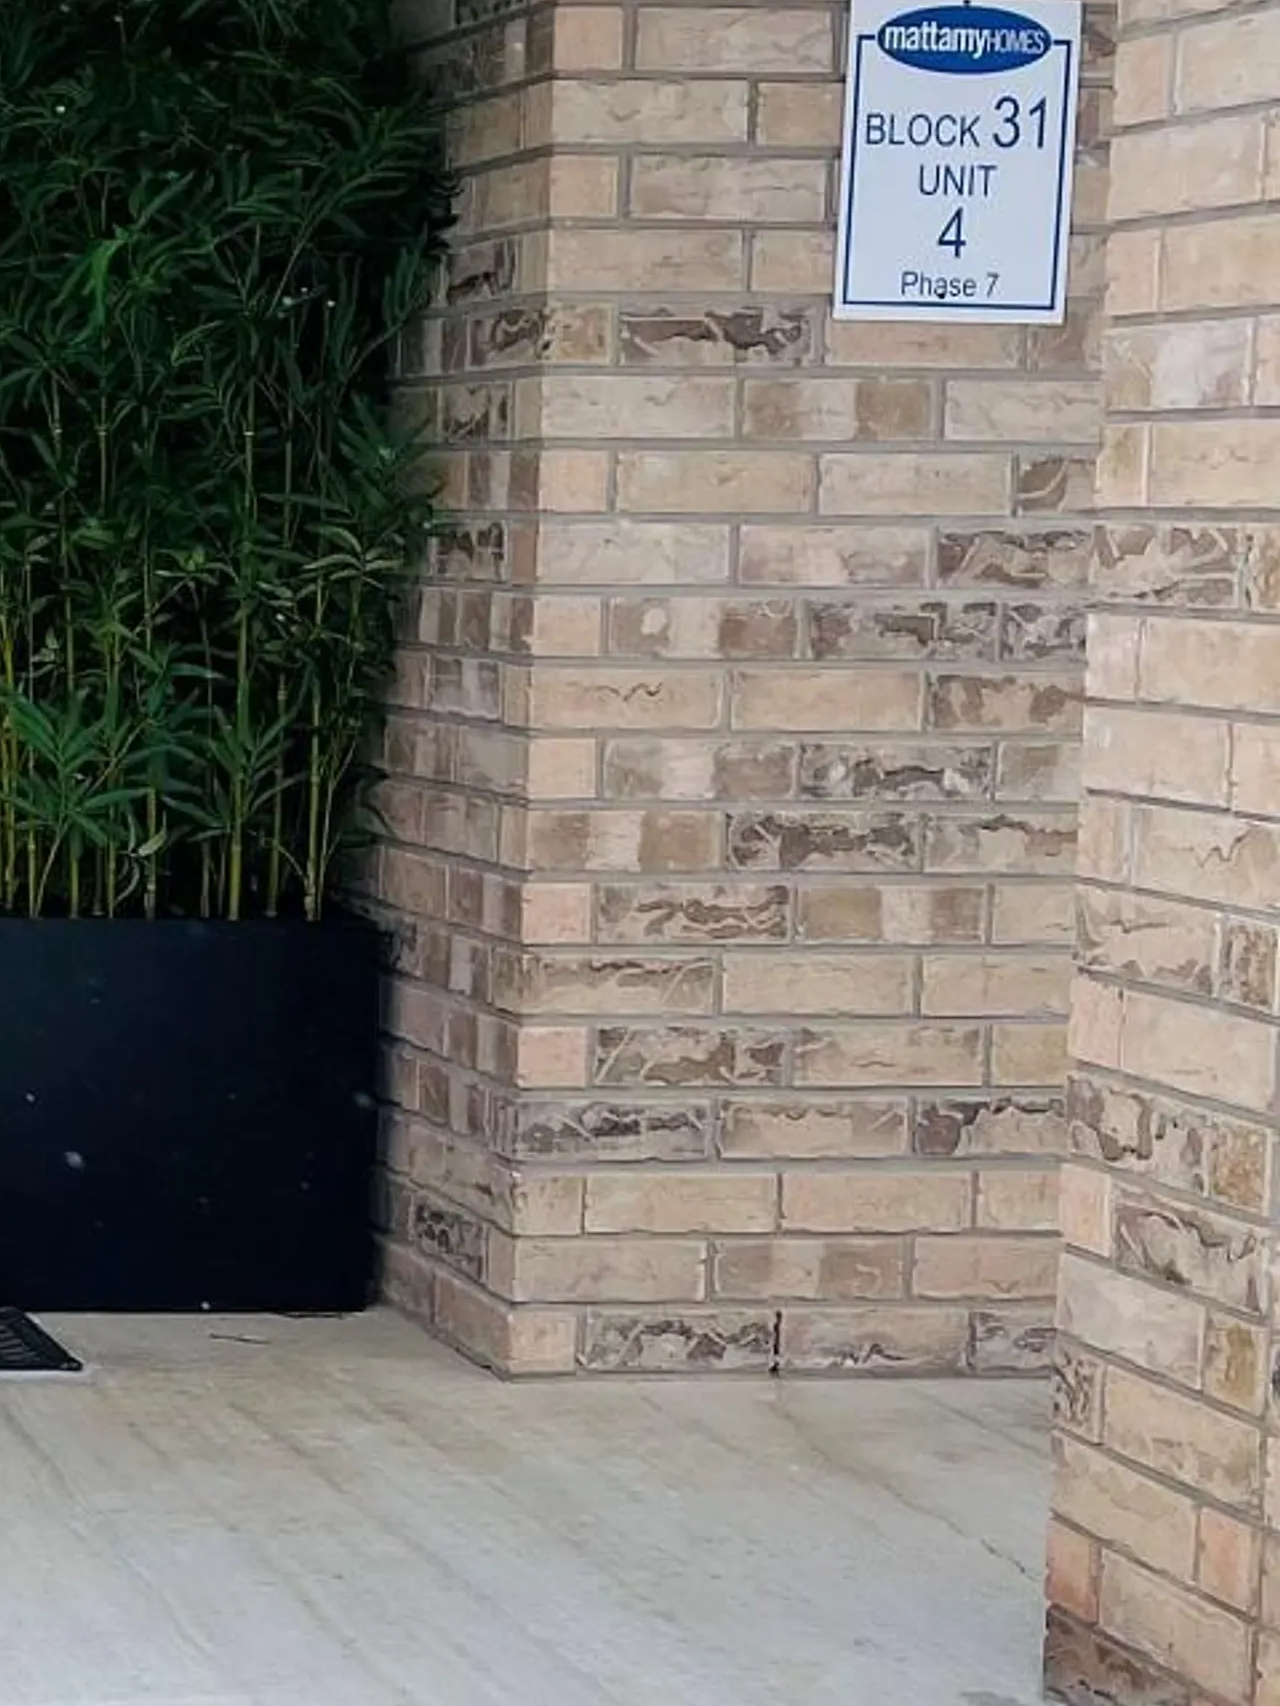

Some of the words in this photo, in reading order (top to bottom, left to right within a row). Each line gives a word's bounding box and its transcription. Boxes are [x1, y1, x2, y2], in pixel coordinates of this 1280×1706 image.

[865, 113, 980, 147] BLOCK
[992, 96, 1046, 148] 31
[919, 164, 997, 196] UNIT
[937, 207, 967, 258] 4
[900, 270, 977, 298] Phase
[986, 272, 1000, 298] 7
